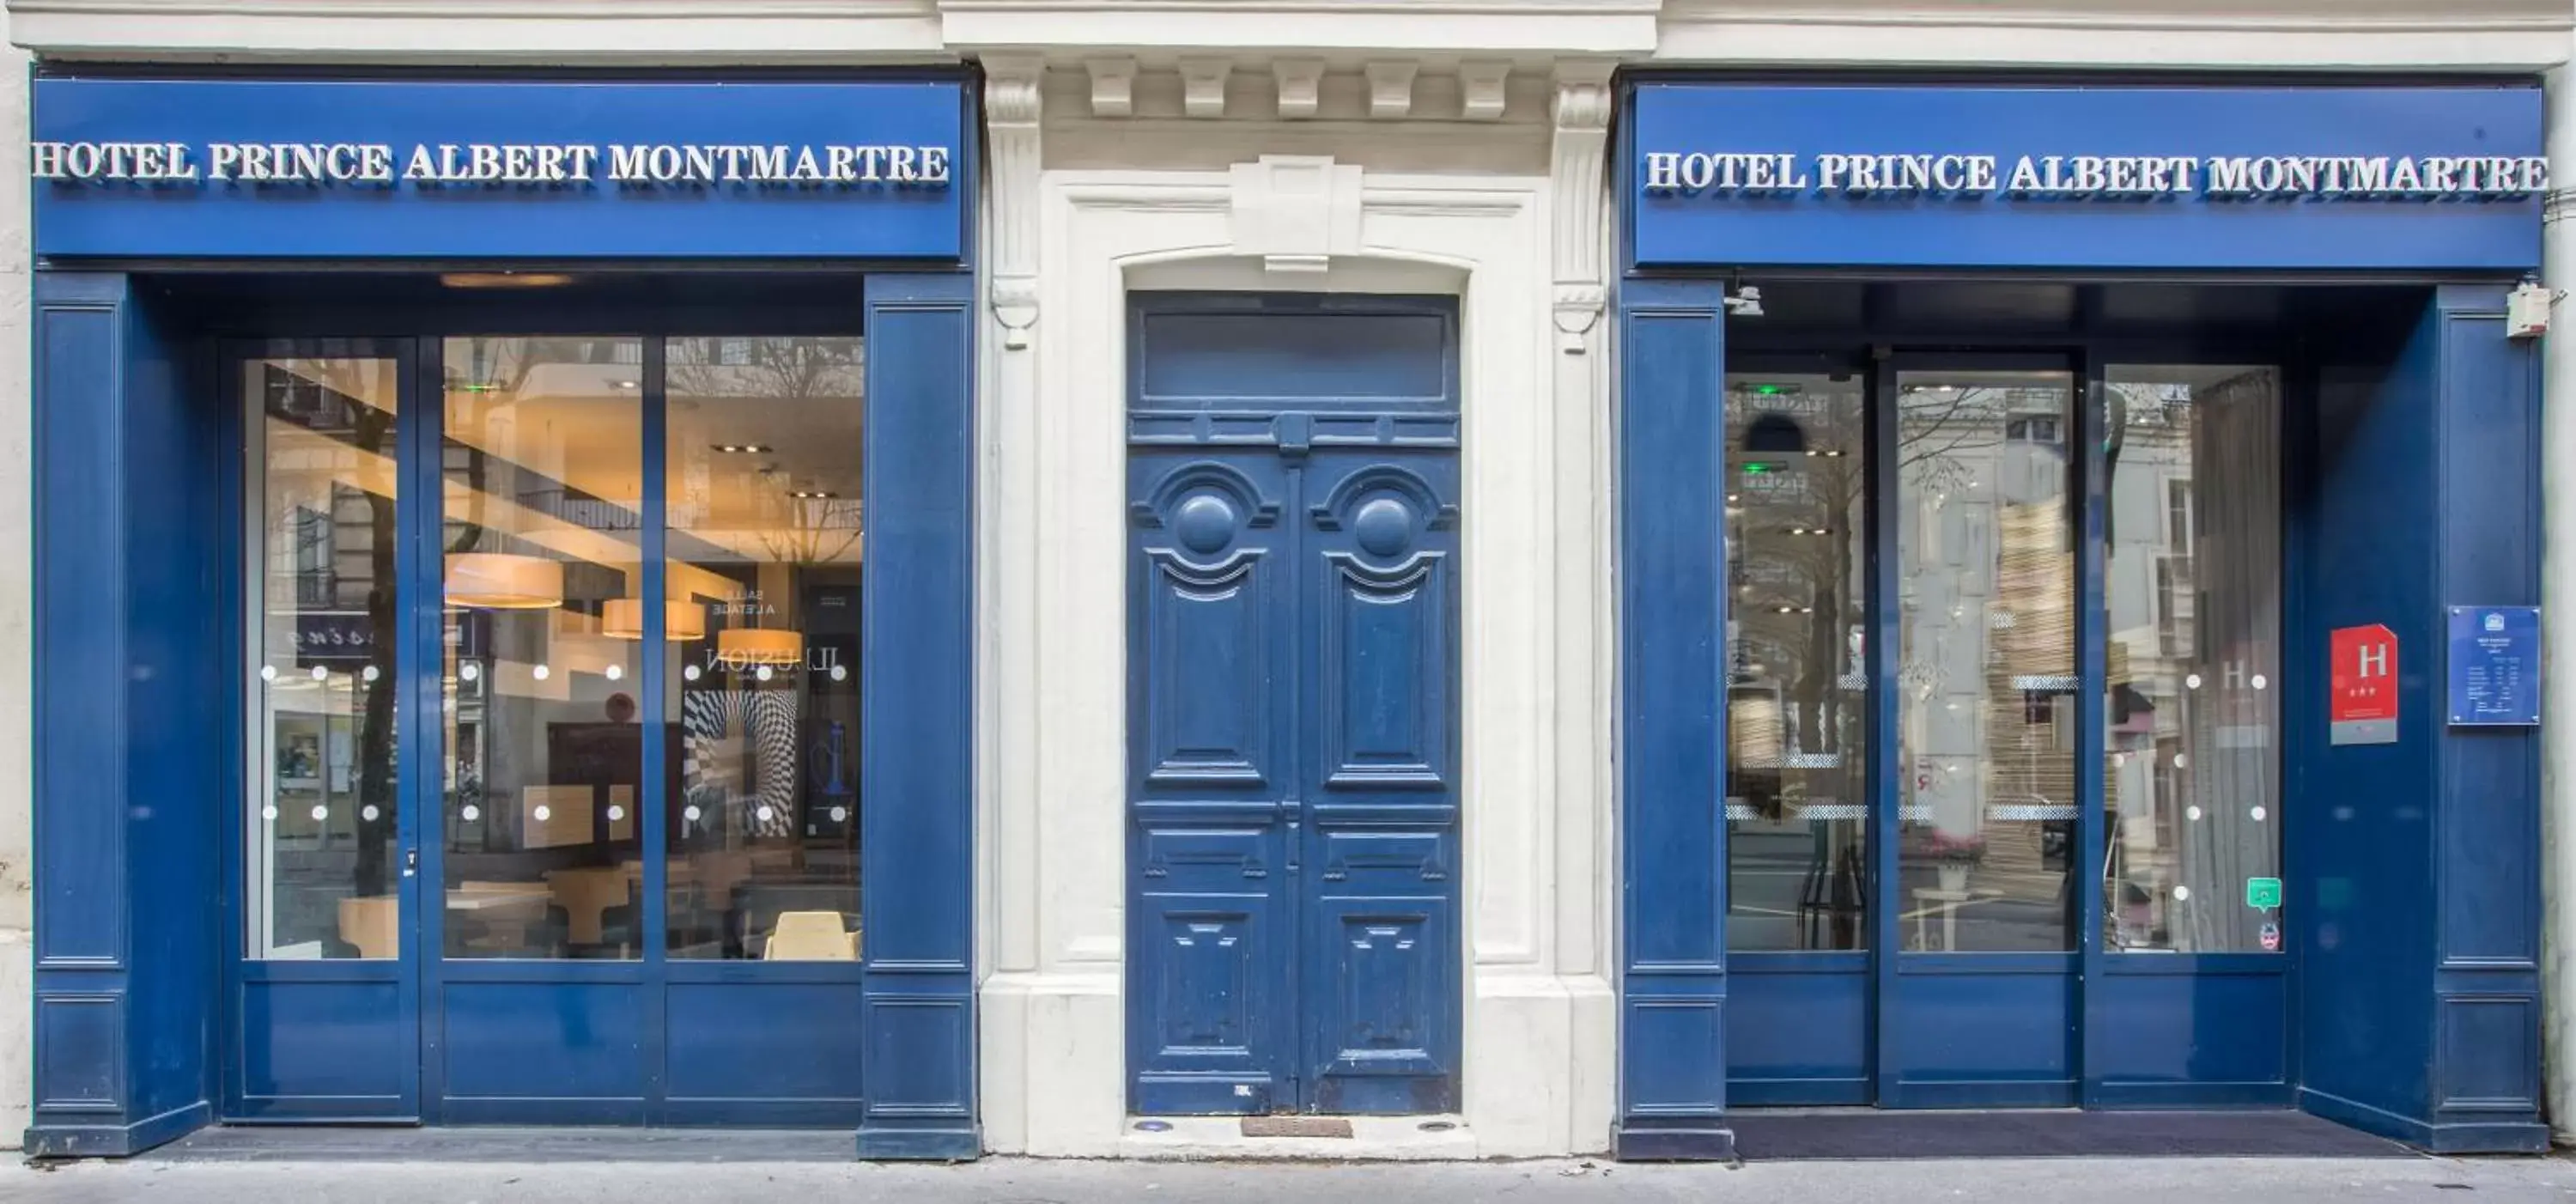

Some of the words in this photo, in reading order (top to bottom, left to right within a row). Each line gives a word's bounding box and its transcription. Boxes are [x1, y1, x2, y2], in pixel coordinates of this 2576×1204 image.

[31, 142, 197, 179] HOTEL
[209, 143, 392, 180] PRINCE
[403, 143, 596, 180] ALBERT
[608, 144, 950, 182] MONTMARTRE
[1645, 153, 1806, 189] HOTEL
[1819, 154, 1996, 191] PRINCE
[2010, 155, 2198, 192] ALBERT
[2208, 156, 2549, 192] MONTMARTRE
[2360, 644, 2387, 678] H
